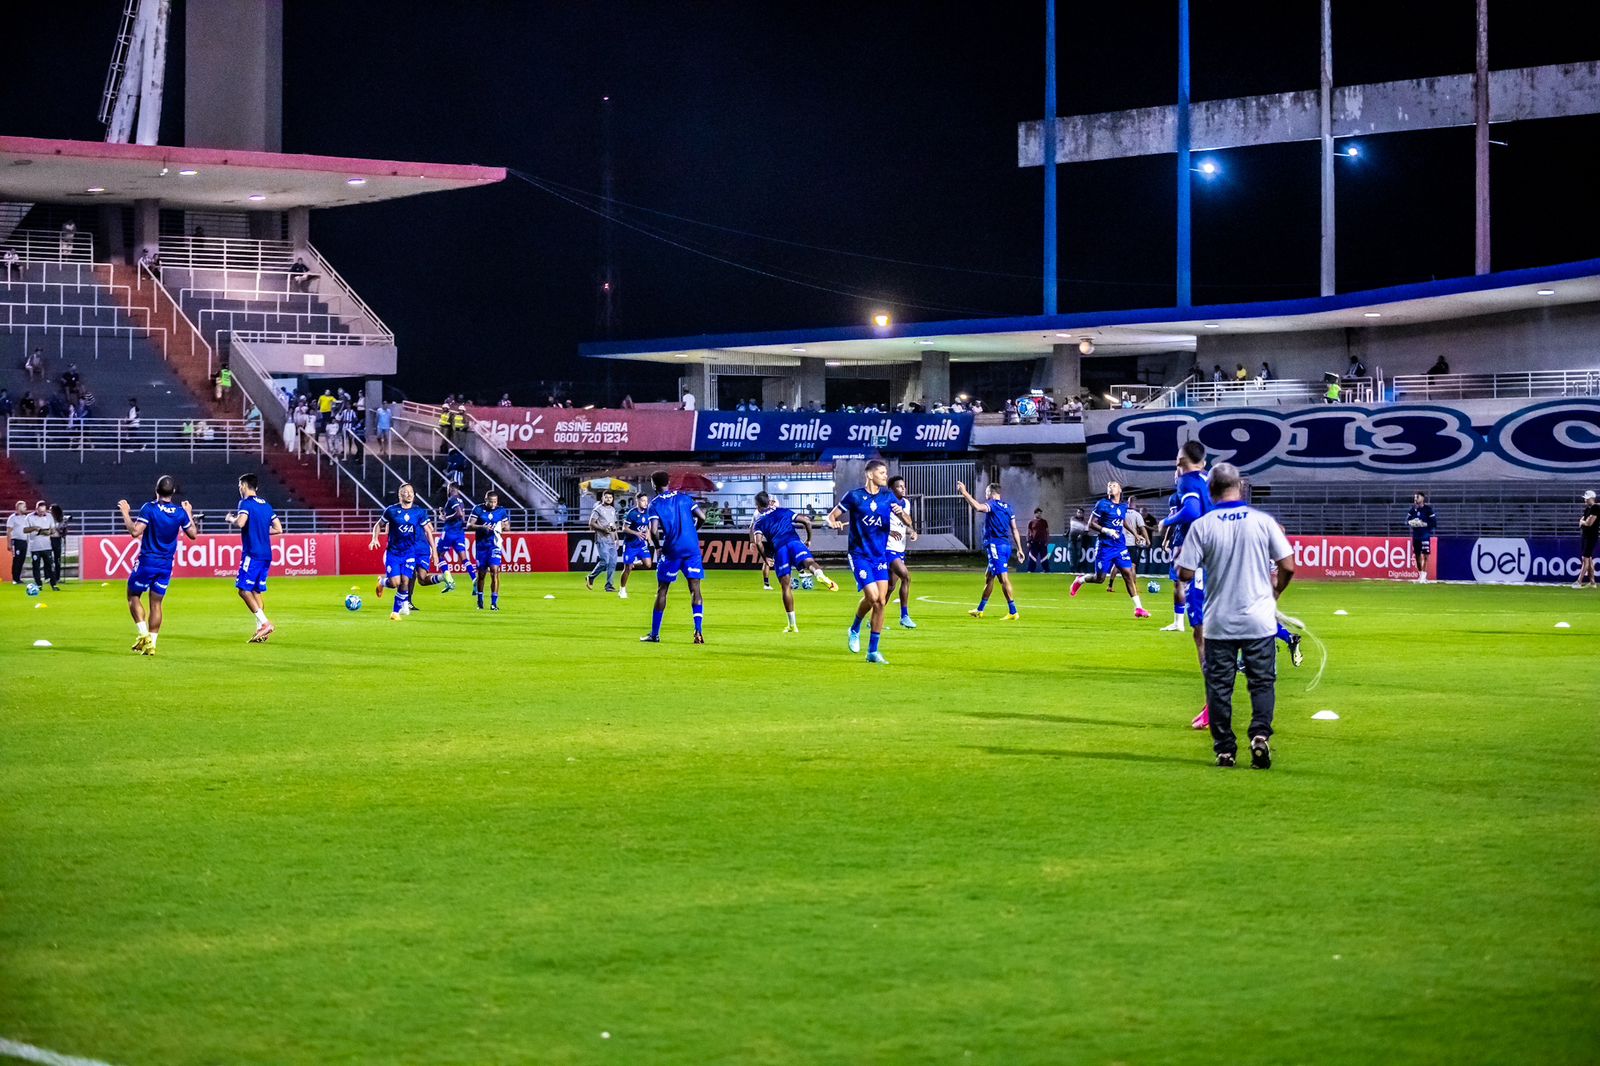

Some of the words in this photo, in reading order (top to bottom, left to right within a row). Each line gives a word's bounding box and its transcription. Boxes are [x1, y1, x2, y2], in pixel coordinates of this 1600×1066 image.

[553, 432, 579, 443] 0800
[582, 433, 601, 443] 720
[603, 433, 629, 443] 1234
[555, 422, 591, 432] ASSINE
[595, 422, 628, 432] AGORA
[708, 417, 761, 441] smile
[778, 418, 832, 442] smile
[847, 418, 902, 442] smile
[915, 418, 960, 441] smile
[721, 440, 742, 448] SAÚDE
[794, 441, 815, 449] SAÚDE
[1122, 413, 1465, 472] 1913
[1217, 511, 1249, 522] VOLT
[176, 538, 308, 567] talmdel
[699, 540, 764, 564] ANH
[1293, 539, 1411, 568] talmodel
[1477, 544, 1526, 575] bet
[213, 569, 240, 577] Segura
[285, 568, 318, 576] Dignidade
[436, 564, 468, 573] TBOS
[1325, 569, 1355, 577] Segurança
[1388, 570, 1419, 579] Dignidade
